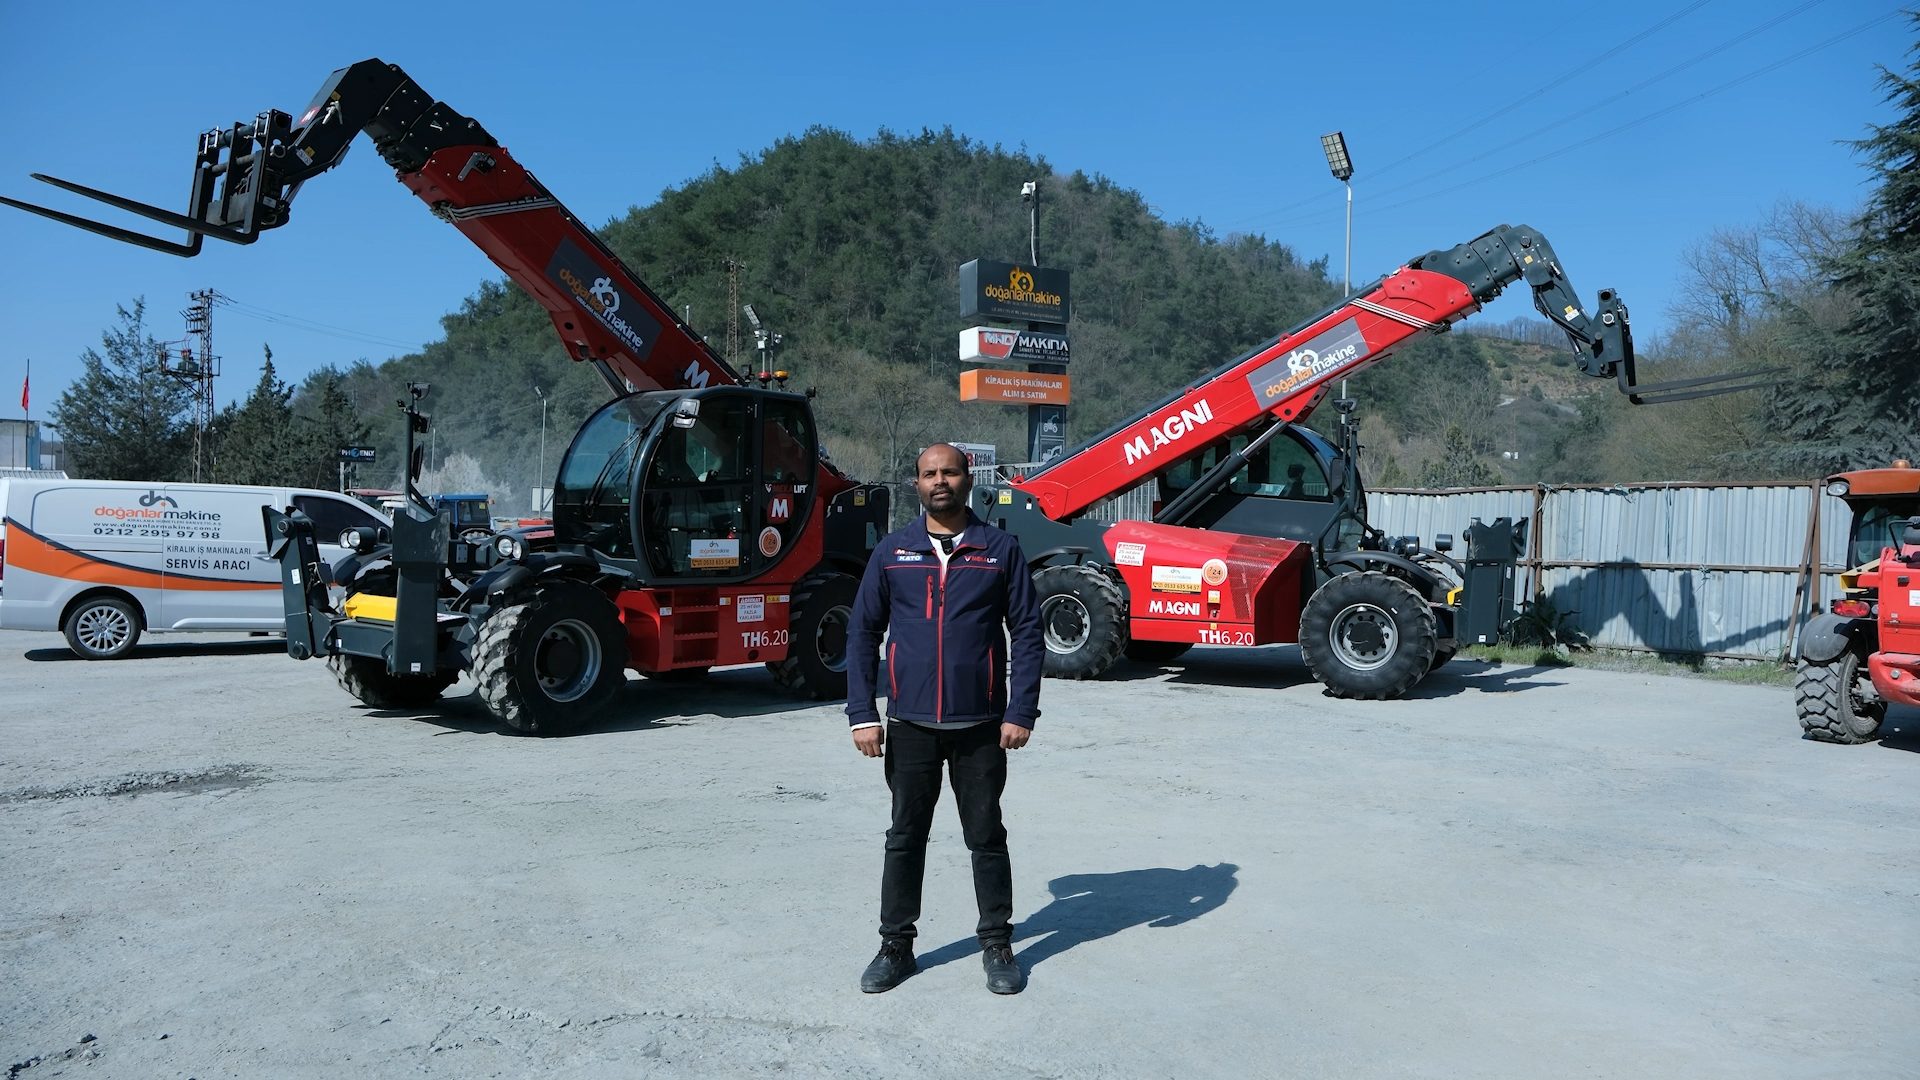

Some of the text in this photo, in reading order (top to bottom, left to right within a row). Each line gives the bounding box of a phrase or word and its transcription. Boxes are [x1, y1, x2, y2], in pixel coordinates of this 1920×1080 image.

[985, 284, 1061, 306] doğanlarmakine
[1265, 344, 1356, 398] doğanlarmakine
[1123, 399, 1214, 465] MAGNI
[94, 506, 221, 520] doğanlarmakine
[771, 498, 789, 518] M
[93, 523, 221, 532] www.doganlarmakine.com.tr
[93, 527, 133, 536] 0212
[140, 529, 170, 537] 295
[177, 530, 194, 538] 97
[166, 544, 196, 553] KİRALIK
[166, 556, 250, 570] SERVİS ARACI
[1149, 600, 1200, 615] MAGNI
[741, 629, 789, 648] TH6.20
[1199, 629, 1254, 646] TH6.20
